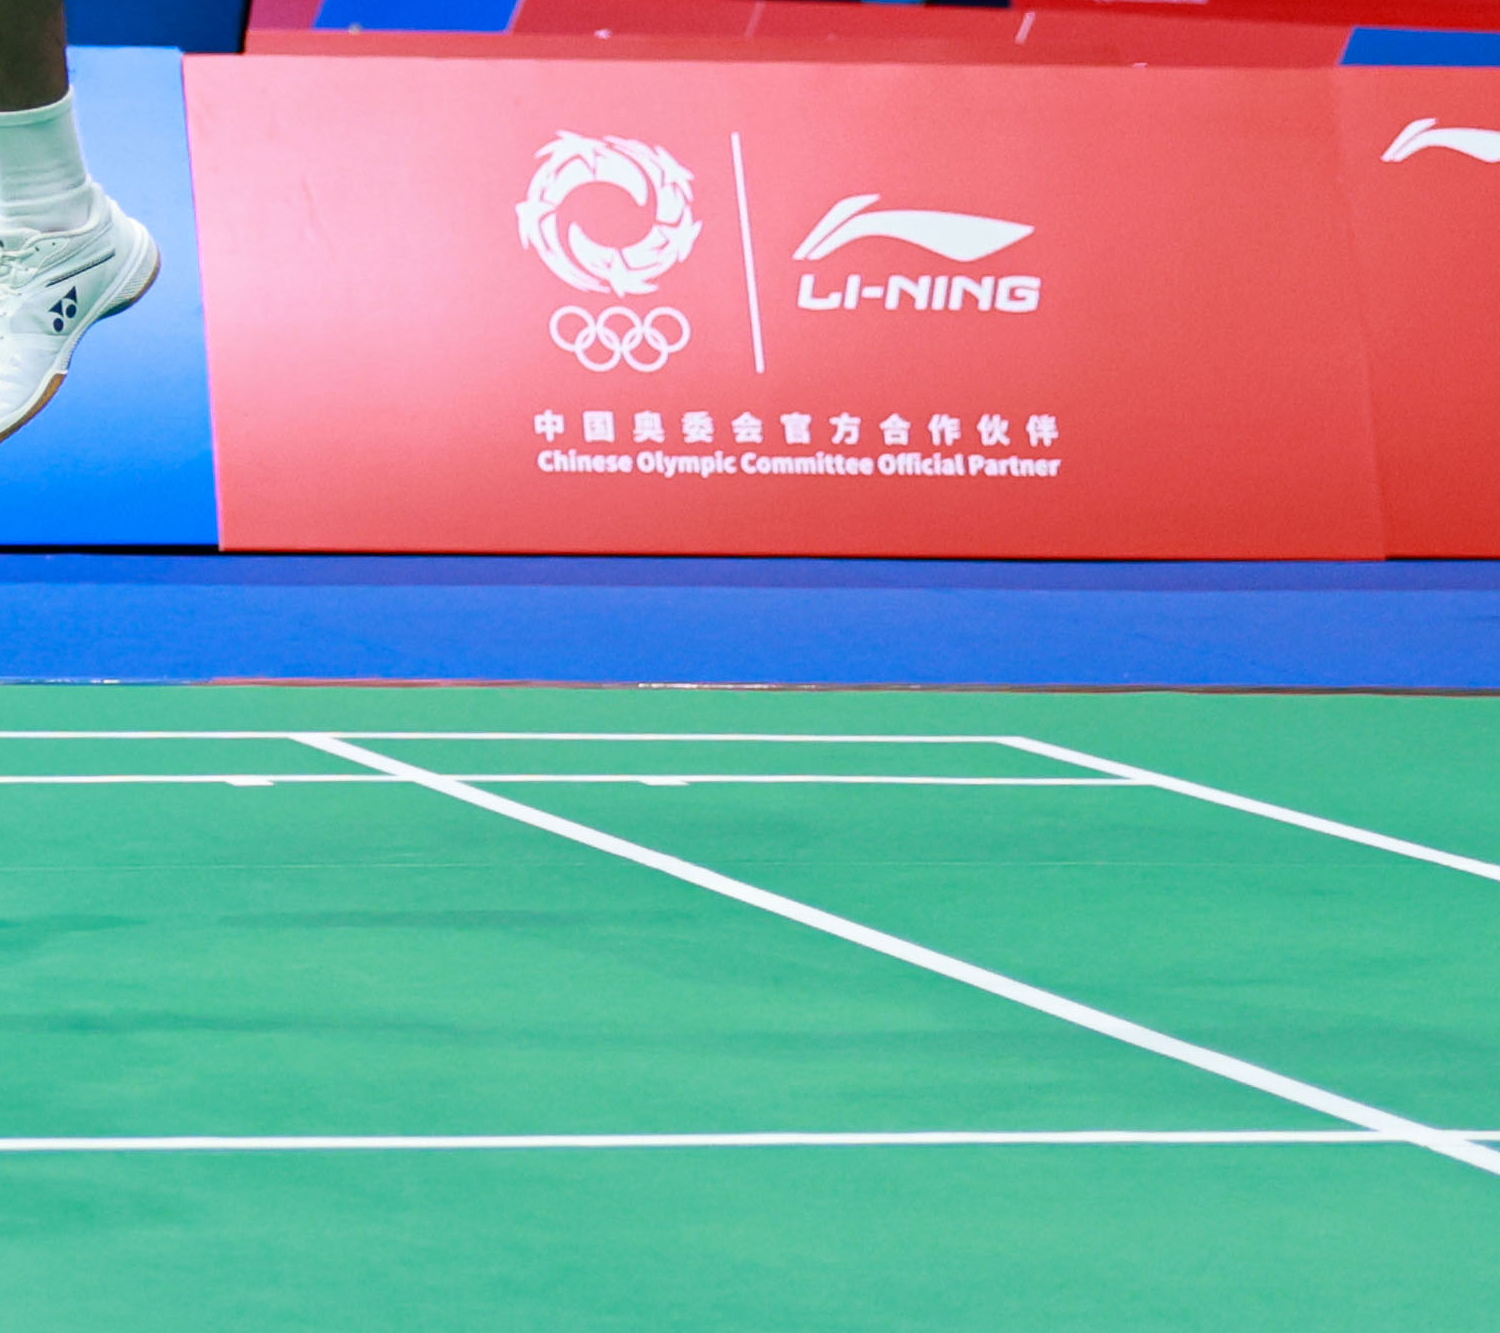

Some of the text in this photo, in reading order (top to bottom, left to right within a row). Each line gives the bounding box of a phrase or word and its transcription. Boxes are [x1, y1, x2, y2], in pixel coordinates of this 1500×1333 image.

[797, 274, 1042, 313] LI-NING
[533, 408, 1060, 448] 中国奥委会官方合作伙伴
[536, 448, 1062, 478] Chinese Olympic Committee Official Partner
